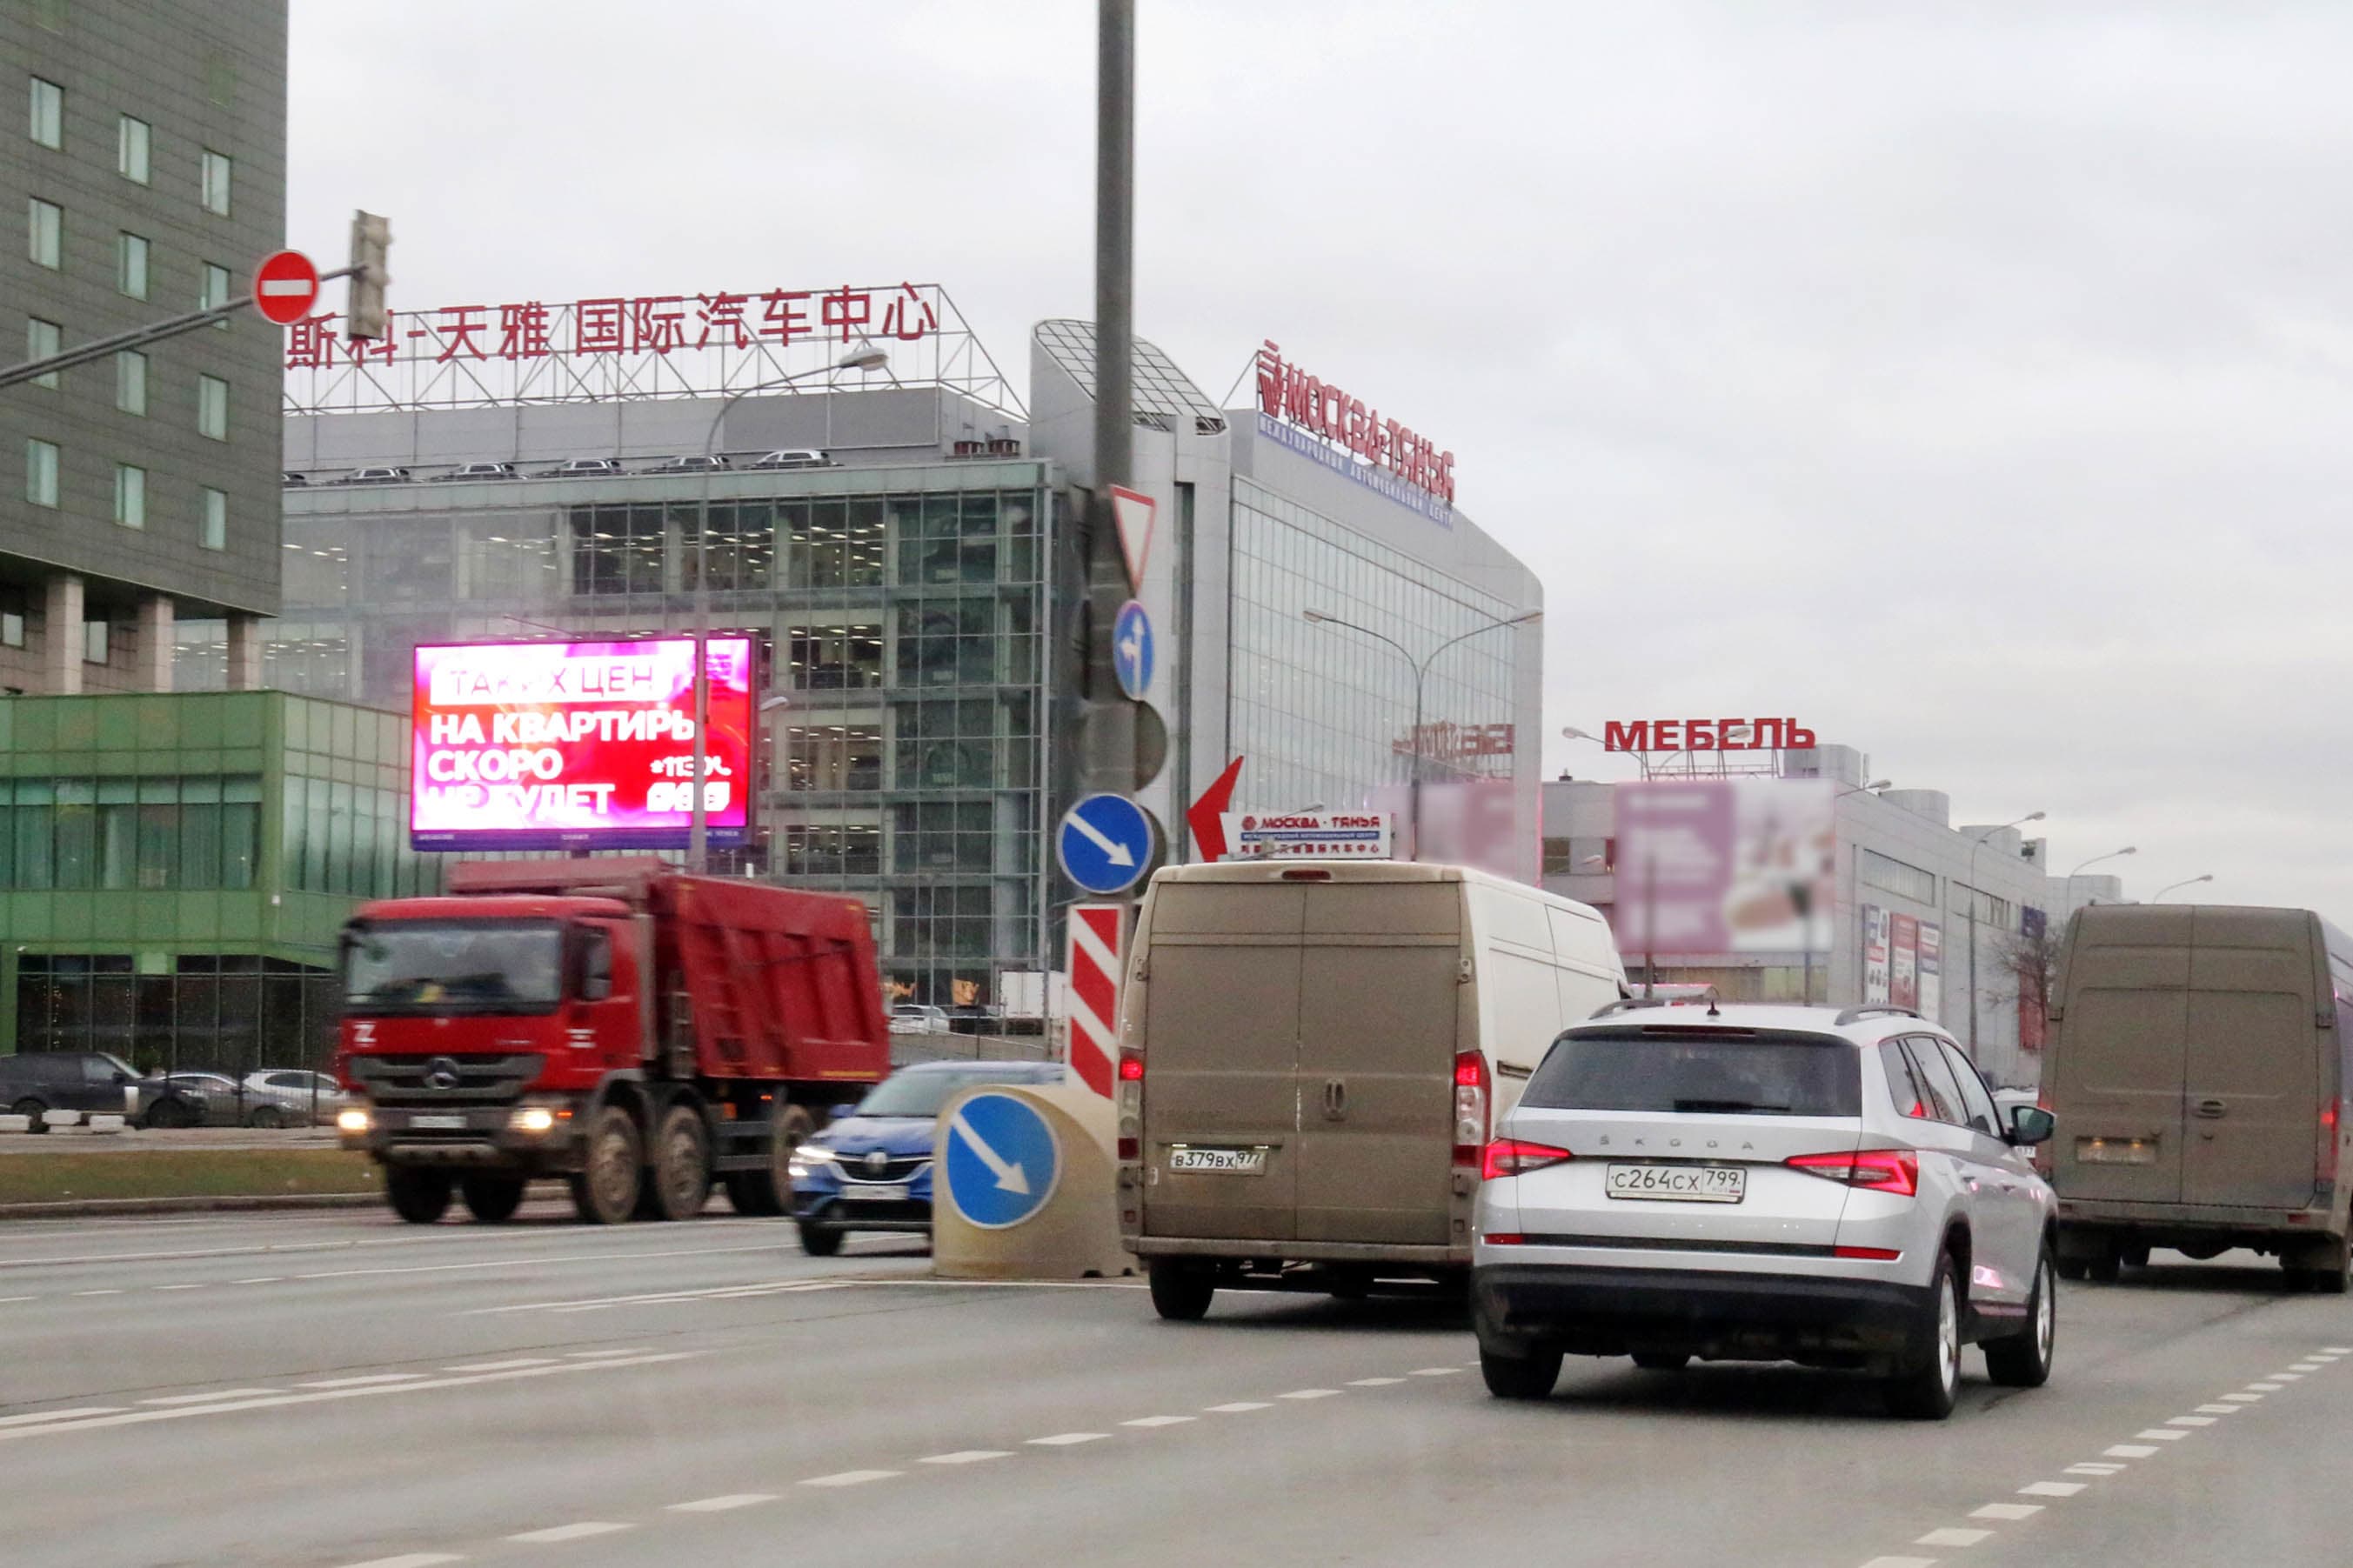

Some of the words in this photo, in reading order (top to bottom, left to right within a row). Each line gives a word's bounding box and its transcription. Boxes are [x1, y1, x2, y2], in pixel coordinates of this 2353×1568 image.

[582, 665, 652, 697] ЦЕН
[431, 713, 485, 744] НА
[1605, 717, 1816, 751] МЕБЕЛЬ
[428, 748, 564, 782] СКОРО
[1261, 817, 1320, 829] МОСКВА
[1331, 816, 1380, 828] ТЯНЬЯ
[1706, 1170, 1738, 1186] 799
